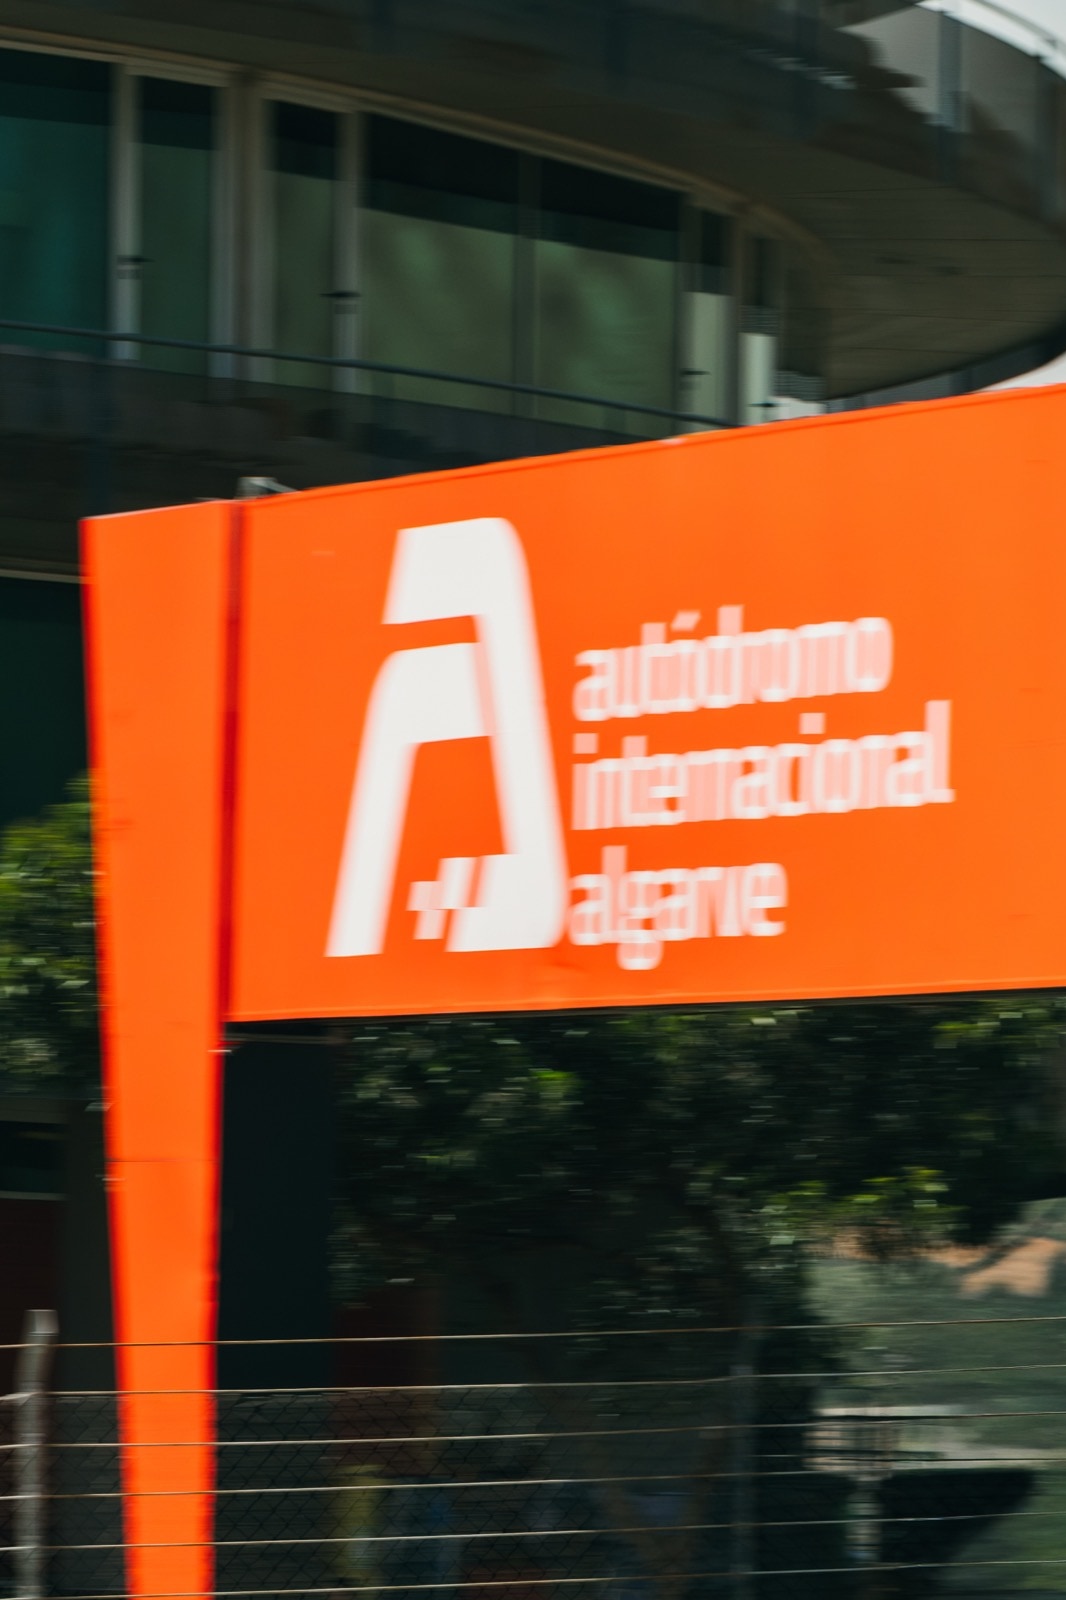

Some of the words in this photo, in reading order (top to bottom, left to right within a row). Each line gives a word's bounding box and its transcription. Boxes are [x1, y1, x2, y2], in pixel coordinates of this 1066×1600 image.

[573, 604, 893, 721] autódromo
[572, 700, 955, 831] internacional
[568, 845, 788, 970] algarve
